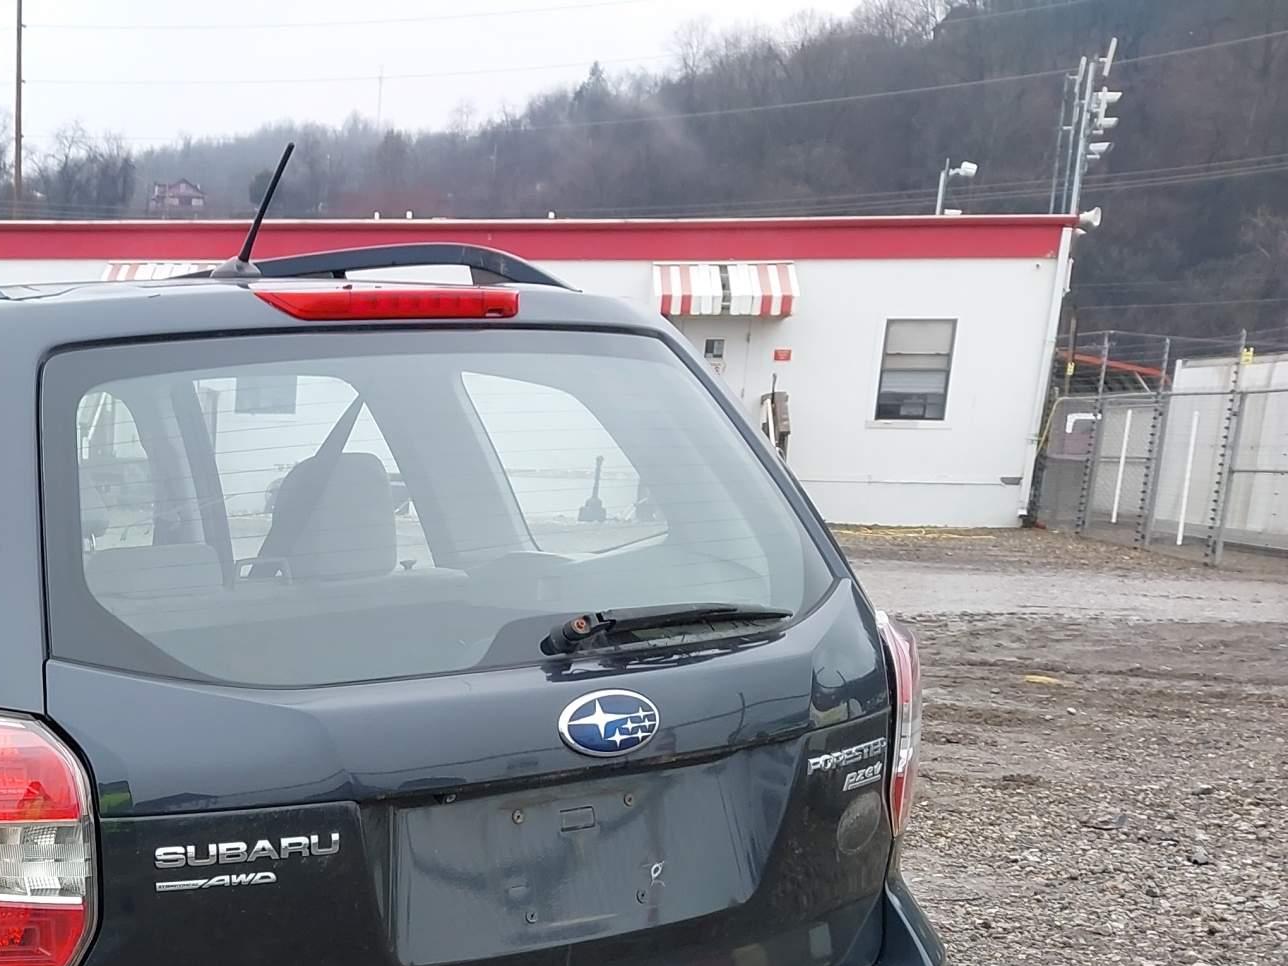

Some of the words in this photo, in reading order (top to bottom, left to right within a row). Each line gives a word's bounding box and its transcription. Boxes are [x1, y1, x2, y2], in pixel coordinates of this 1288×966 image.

[807, 737, 887, 776] FORESTER
[154, 832, 340, 869] SUBARU
[201, 871, 277, 889] AWD
